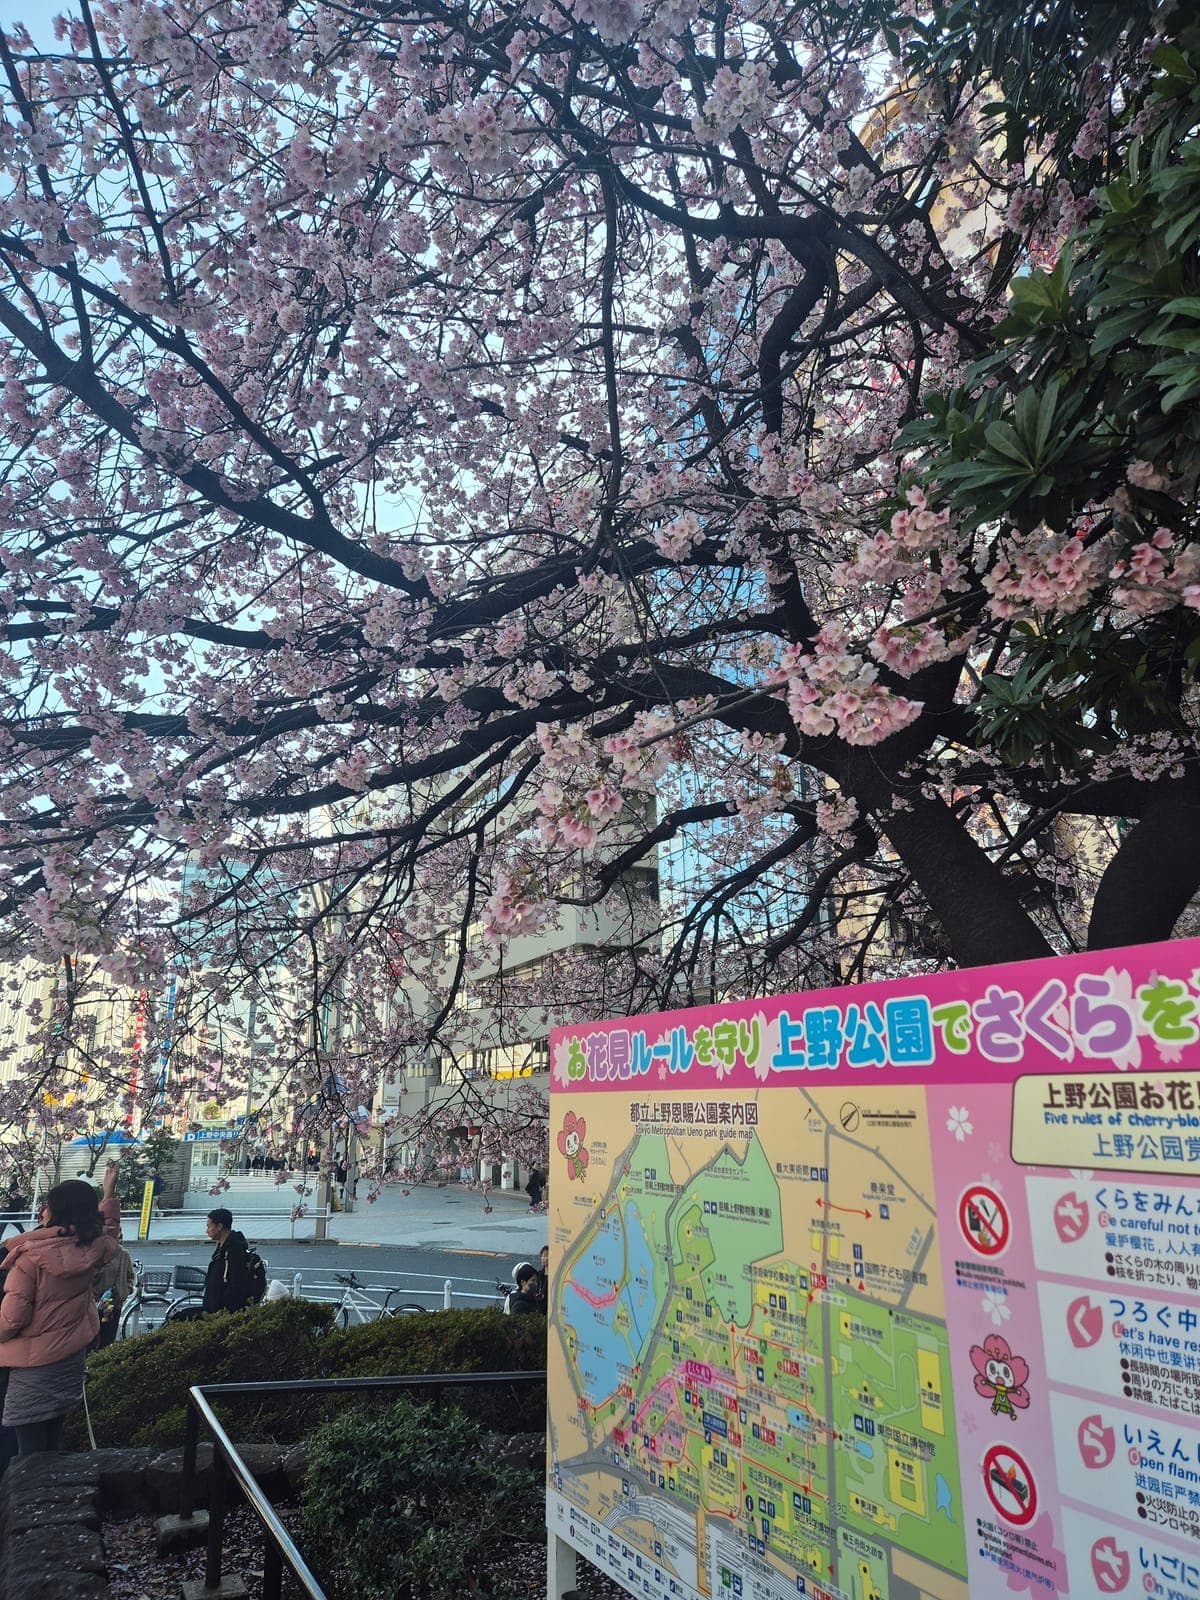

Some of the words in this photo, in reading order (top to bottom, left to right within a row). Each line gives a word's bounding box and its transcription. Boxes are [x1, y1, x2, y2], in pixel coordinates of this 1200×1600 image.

[567, 1019, 761, 1081] お花見ルールを守り
[772, 976, 1200, 1068] 上野公園でさくらを
[1043, 1081, 1200, 1110] 上野公園お花
[630, 1102, 758, 1125] 都立上野恩賜公園案内図
[1044, 1112, 1068, 1125] Five
[1072, 1112, 1103, 1125] rules
[1108, 1112, 1122, 1125] of
[1128, 1113, 1200, 1129] cherry-blo
[635, 1124, 650, 1136] Tokyo
[652, 1125, 686, 1137] Metropolitan
[687, 1127, 702, 1137] Ueno
[704, 1127, 718, 1139] park
[719, 1128, 737, 1140] guide
[738, 1130, 753, 1141] map
[1095, 1187, 1200, 1216] くらをみん
[1120, 1218, 1163, 1232] careful
[1168, 1222, 1190, 1235] not
[1194, 1224, 1200, 1236] t
[1115, 1267, 1200, 1290] 枝を折ったり、物
[1109, 1299, 1197, 1332] つろぐ中
[1149, 1330, 1180, 1348] have
[1119, 1340, 1200, 1371] 休闲中也要讲
[1124, 1424, 1200, 1462] いえん
[1128, 1447, 1164, 1472] Open
[1169, 1462, 1200, 1484] flam
